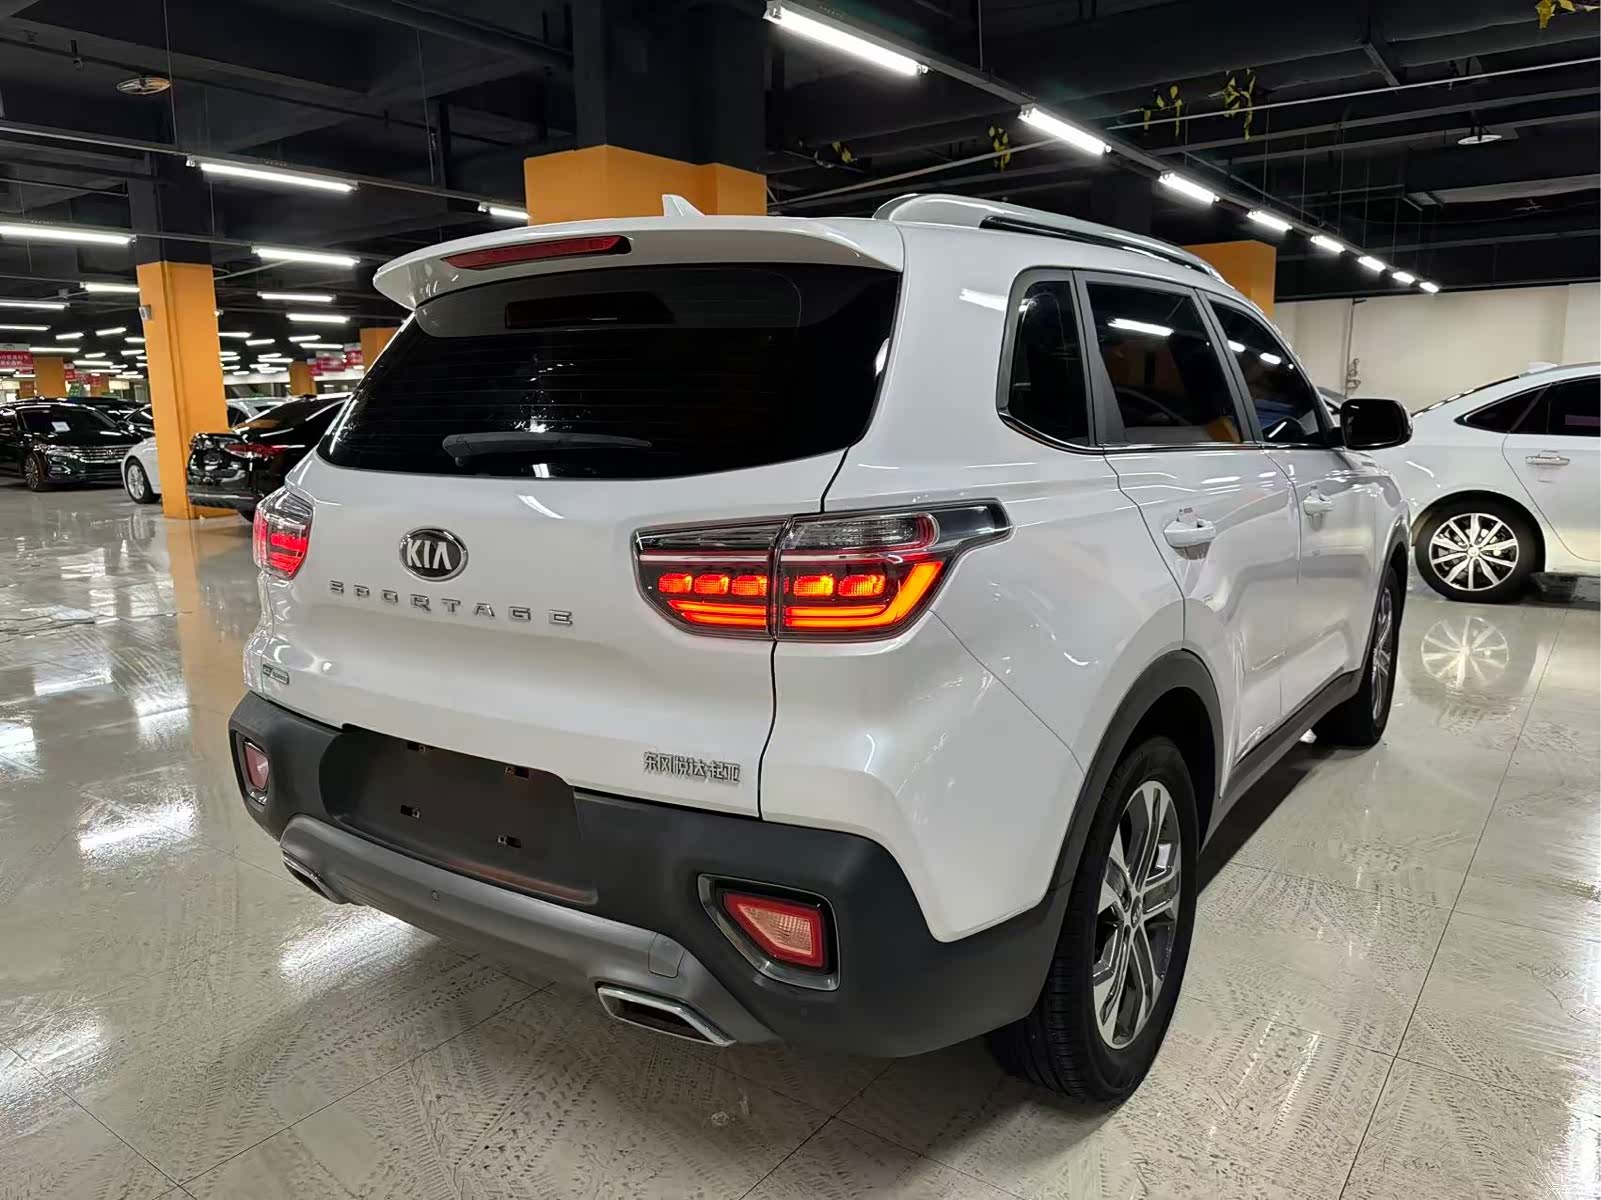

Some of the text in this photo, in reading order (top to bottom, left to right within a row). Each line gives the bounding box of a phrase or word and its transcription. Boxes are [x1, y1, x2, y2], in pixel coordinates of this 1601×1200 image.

[406, 539, 453, 570] KIA
[328, 579, 574, 626] SPORTAGE
[643, 751, 741, 784] 东风悦达起亚
